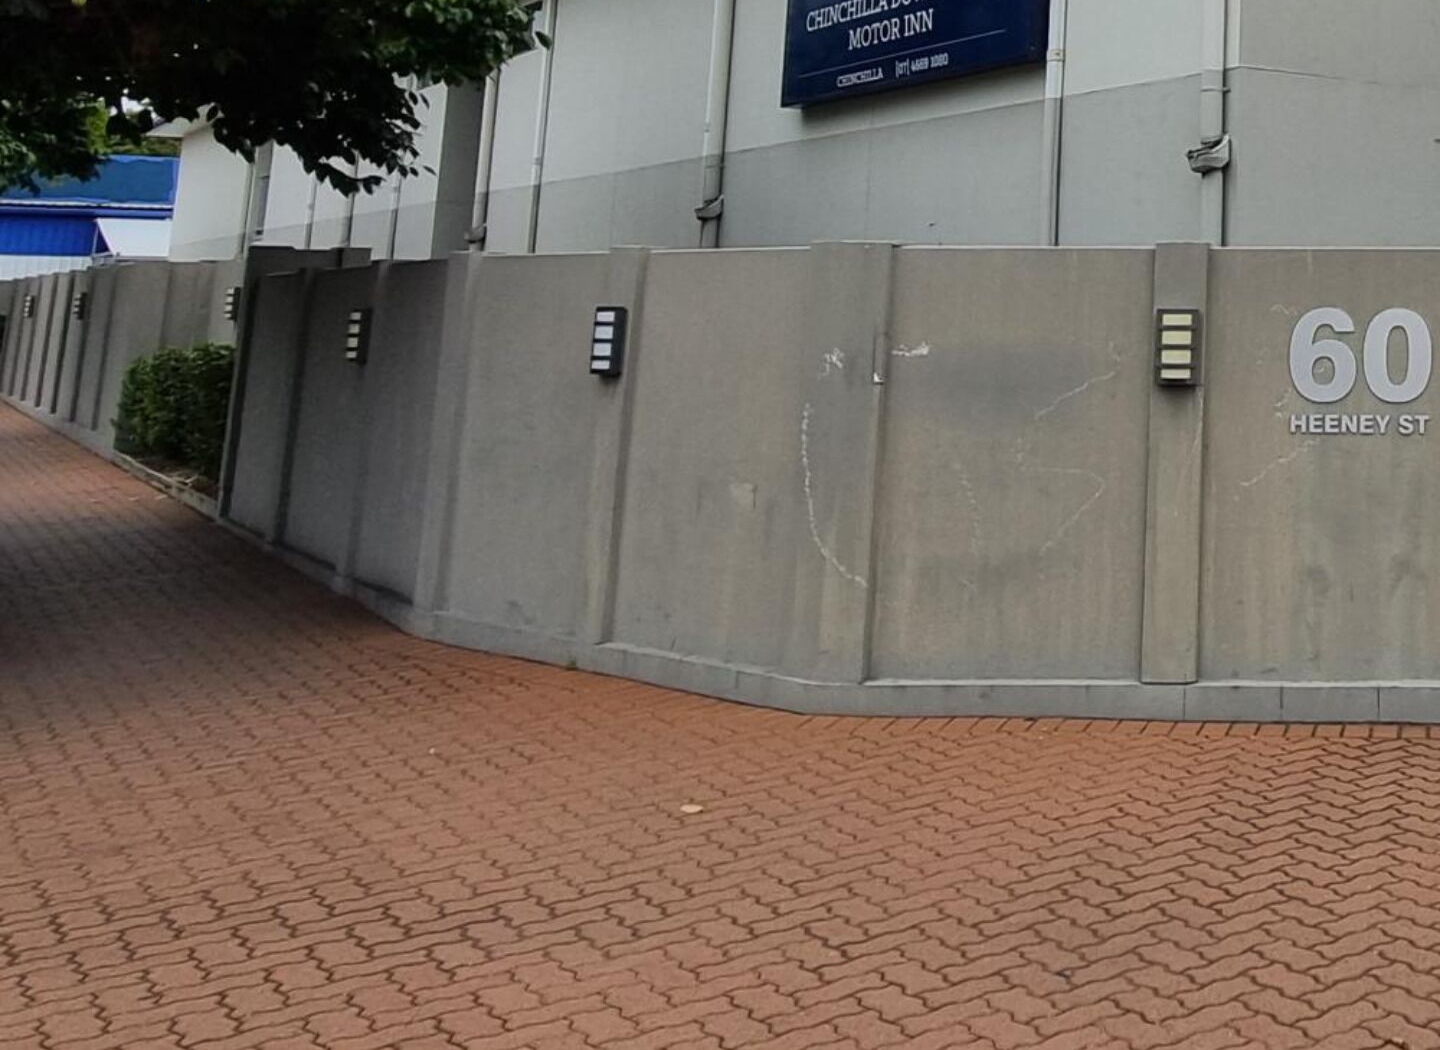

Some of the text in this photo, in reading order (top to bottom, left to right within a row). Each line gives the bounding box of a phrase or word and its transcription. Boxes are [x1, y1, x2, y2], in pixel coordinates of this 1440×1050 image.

[848, 8, 935, 51] MOTOR INN
[1289, 307, 1433, 403] 60
[1289, 413, 1430, 435] HEENEY ST
